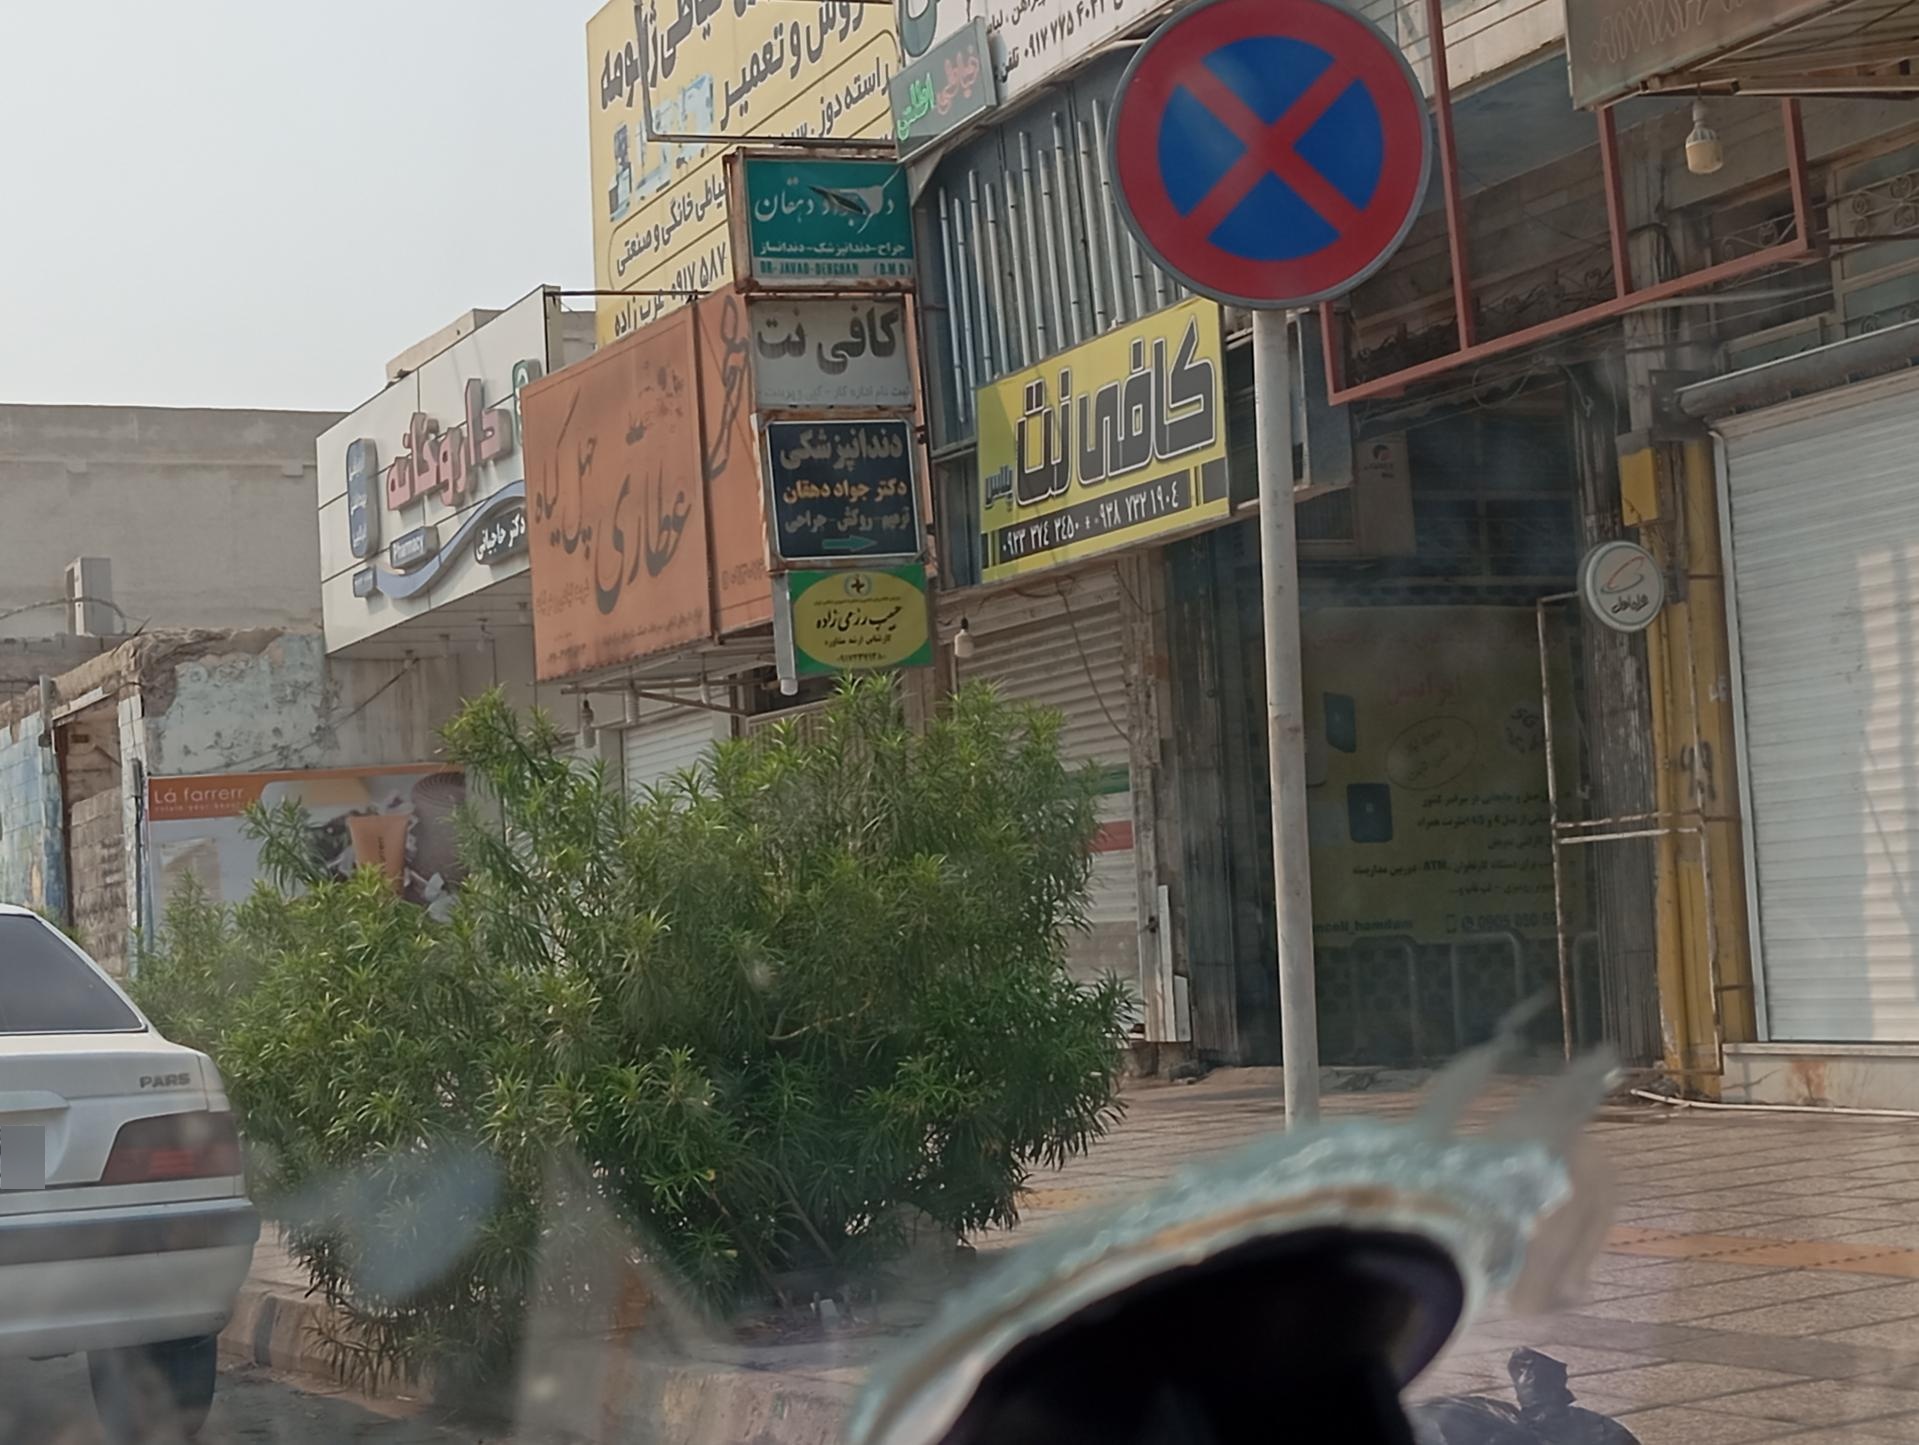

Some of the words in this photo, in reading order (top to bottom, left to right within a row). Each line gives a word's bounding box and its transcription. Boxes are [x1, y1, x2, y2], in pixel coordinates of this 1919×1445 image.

[788, 21, 801, 80] و
[720, 22, 786, 132] تعمیر
[654, 224, 660, 252] و
[662, 192, 694, 245] خانگی
[616, 229, 651, 277] صنعتی
[757, 307, 806, 360] نت
[817, 306, 900, 376] کافی
[1076, 313, 1217, 486] کافی
[781, 427, 903, 471] دندانپزشکی
[1016, 367, 1073, 507] نت
[783, 479, 830, 504] دهقان
[832, 479, 870, 503] جواد
[874, 478, 908, 502] دکتر
[508, 513, 527, 549] دکتر
[594, 458, 692, 616] عطاری
[139, 1072, 191, 1089] PARS
